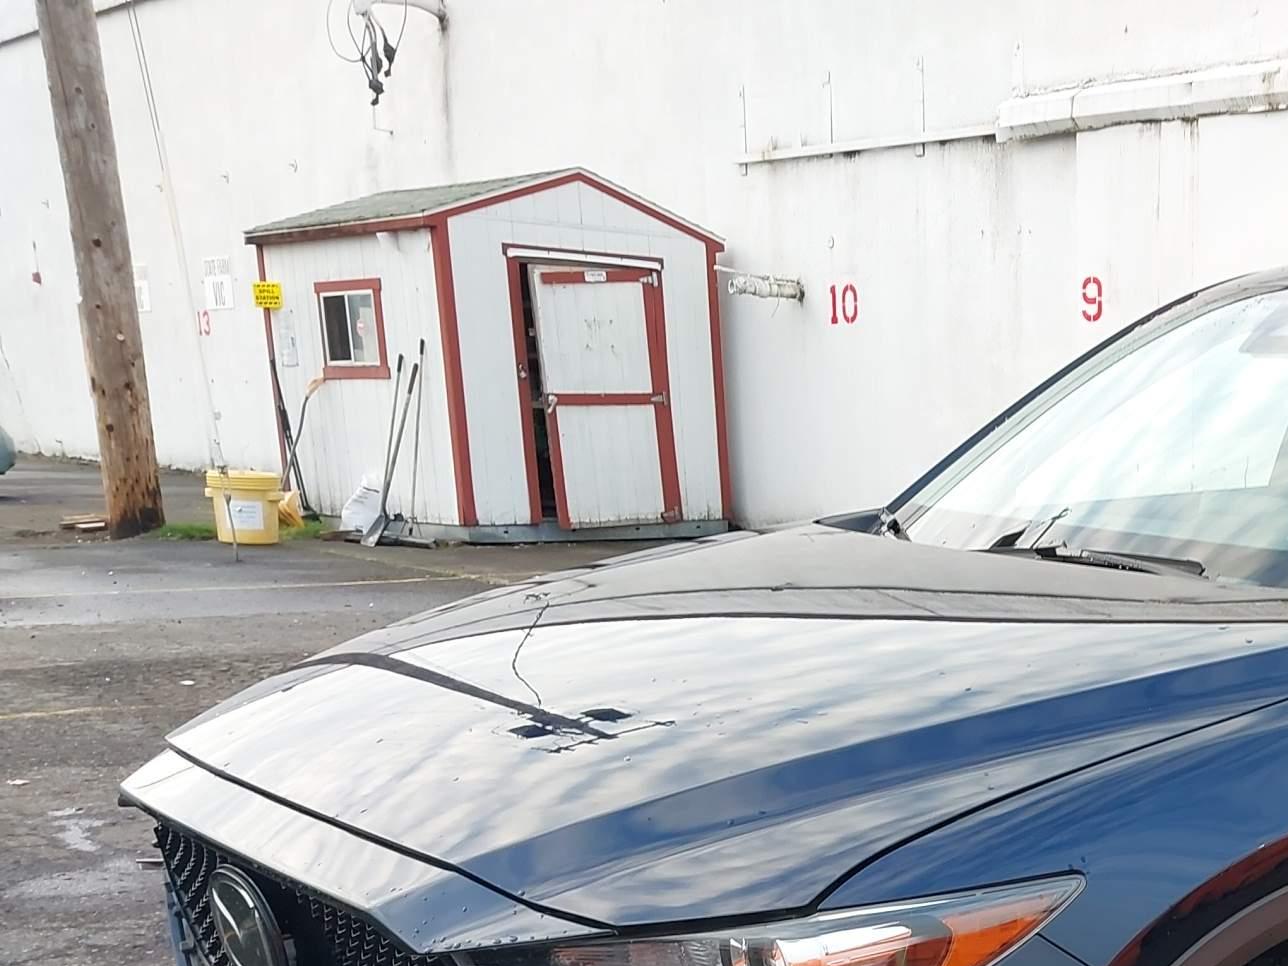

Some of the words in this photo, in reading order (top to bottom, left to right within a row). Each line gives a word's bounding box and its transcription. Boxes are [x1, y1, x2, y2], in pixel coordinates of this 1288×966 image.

[829, 283, 859, 325] 10
[1082, 276, 1103, 322] 9
[197, 310, 211, 336] 13
